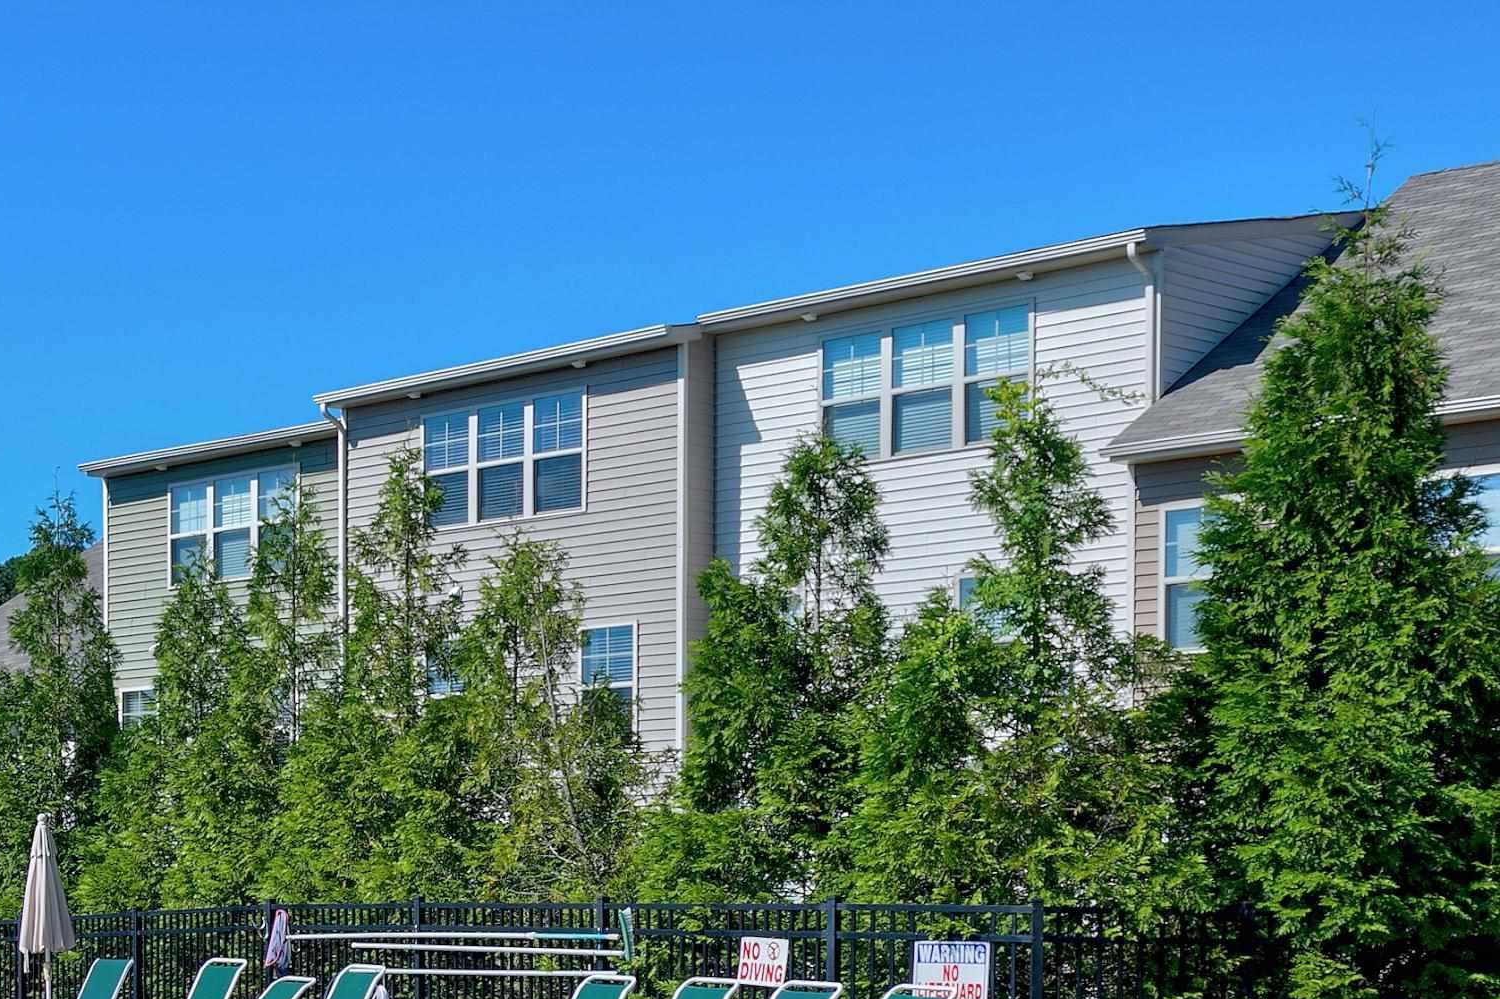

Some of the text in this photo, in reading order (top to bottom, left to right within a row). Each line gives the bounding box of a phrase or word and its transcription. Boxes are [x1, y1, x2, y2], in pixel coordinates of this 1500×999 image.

[743, 942, 760, 960] NO
[918, 943, 986, 963] WARNING
[740, 962, 783, 982] DIVING
[943, 964, 959, 981] NO
